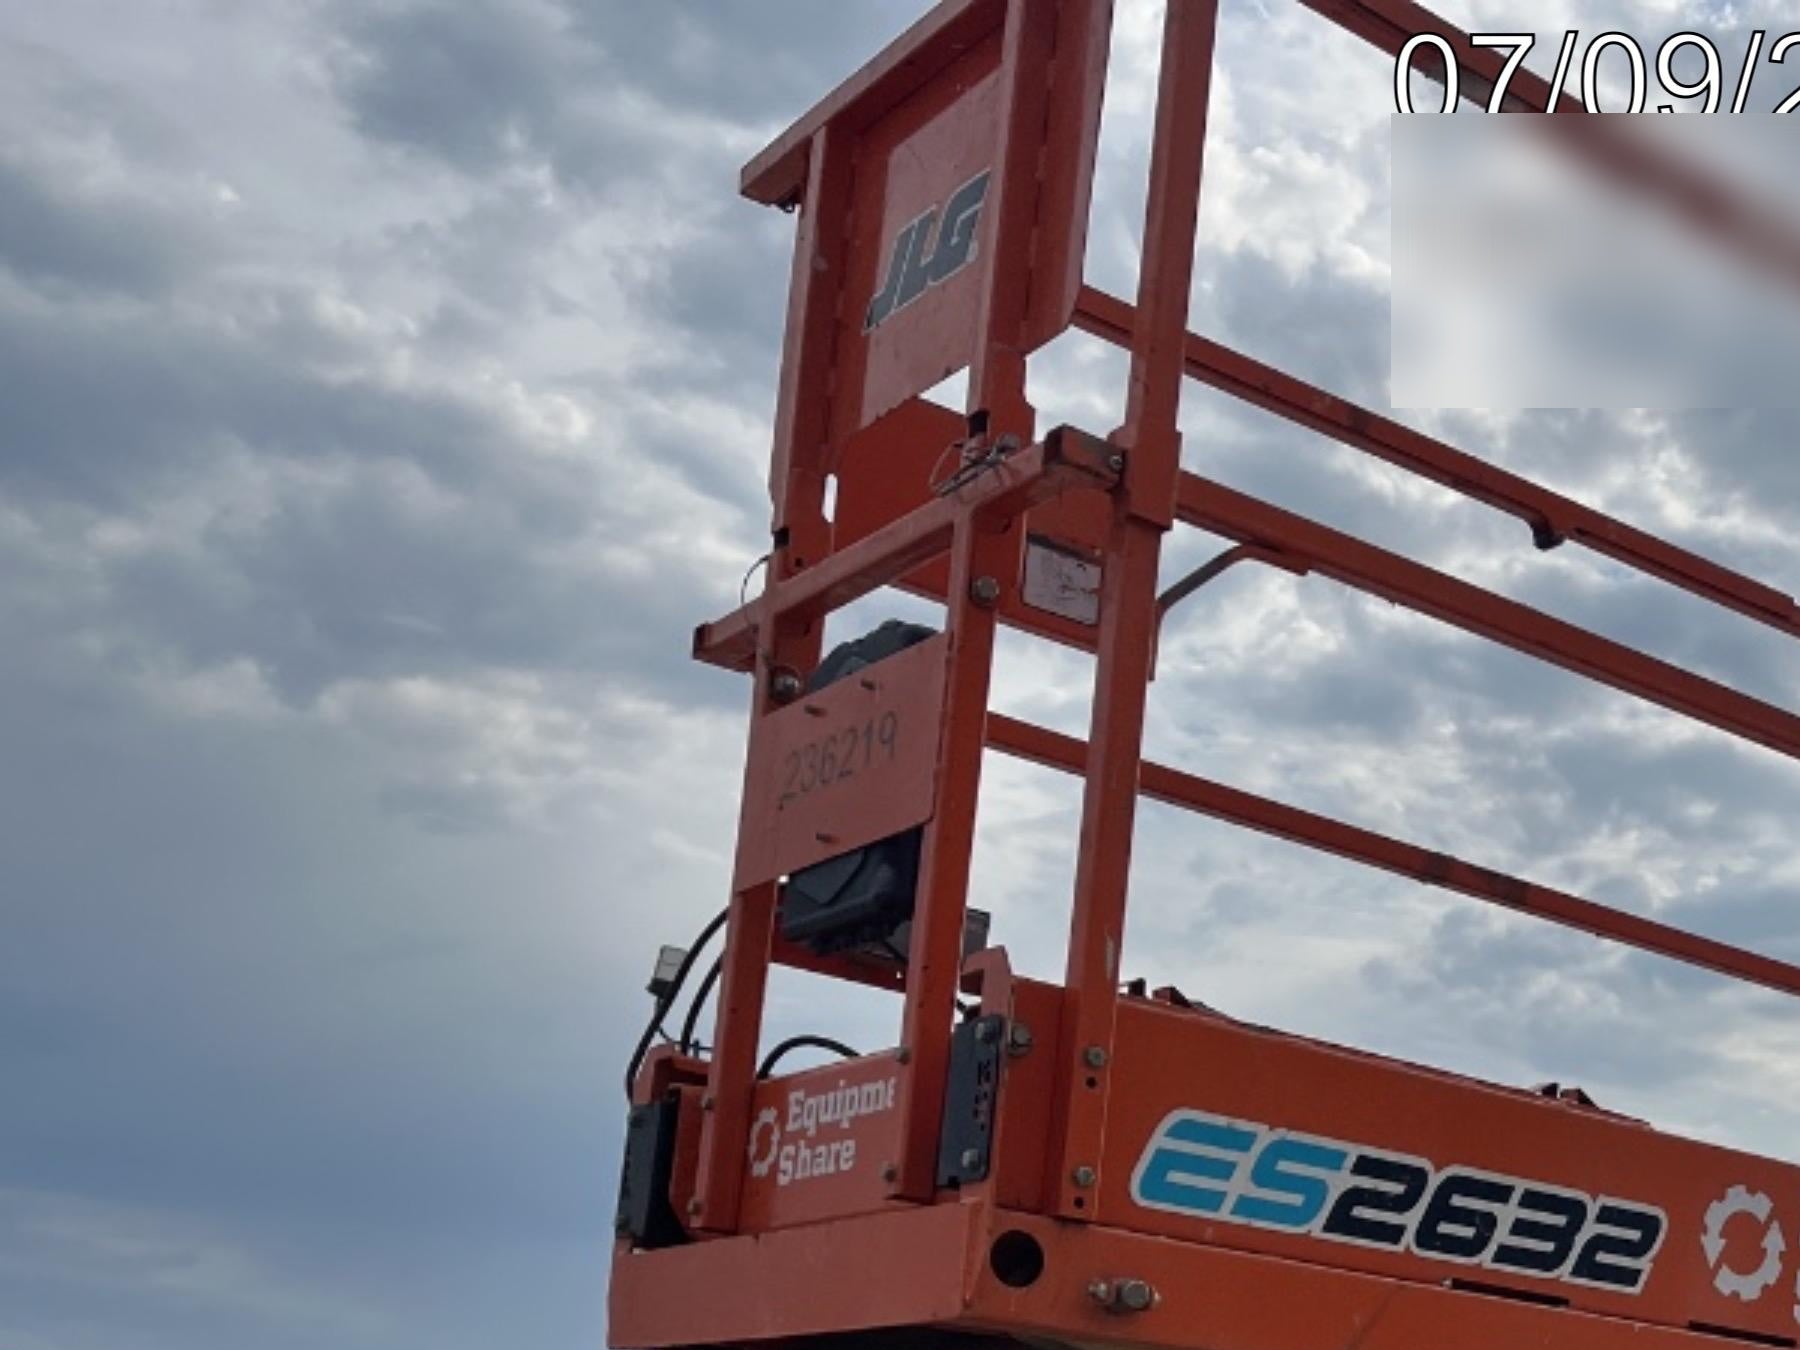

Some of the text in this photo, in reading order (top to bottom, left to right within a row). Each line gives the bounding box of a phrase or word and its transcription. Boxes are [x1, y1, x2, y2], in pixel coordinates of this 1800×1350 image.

[861, 170, 991, 334] JLG
[781, 711, 898, 801] 236219
[777, 1140, 856, 1186] Share
[1130, 1107, 1669, 1295] ES2632
